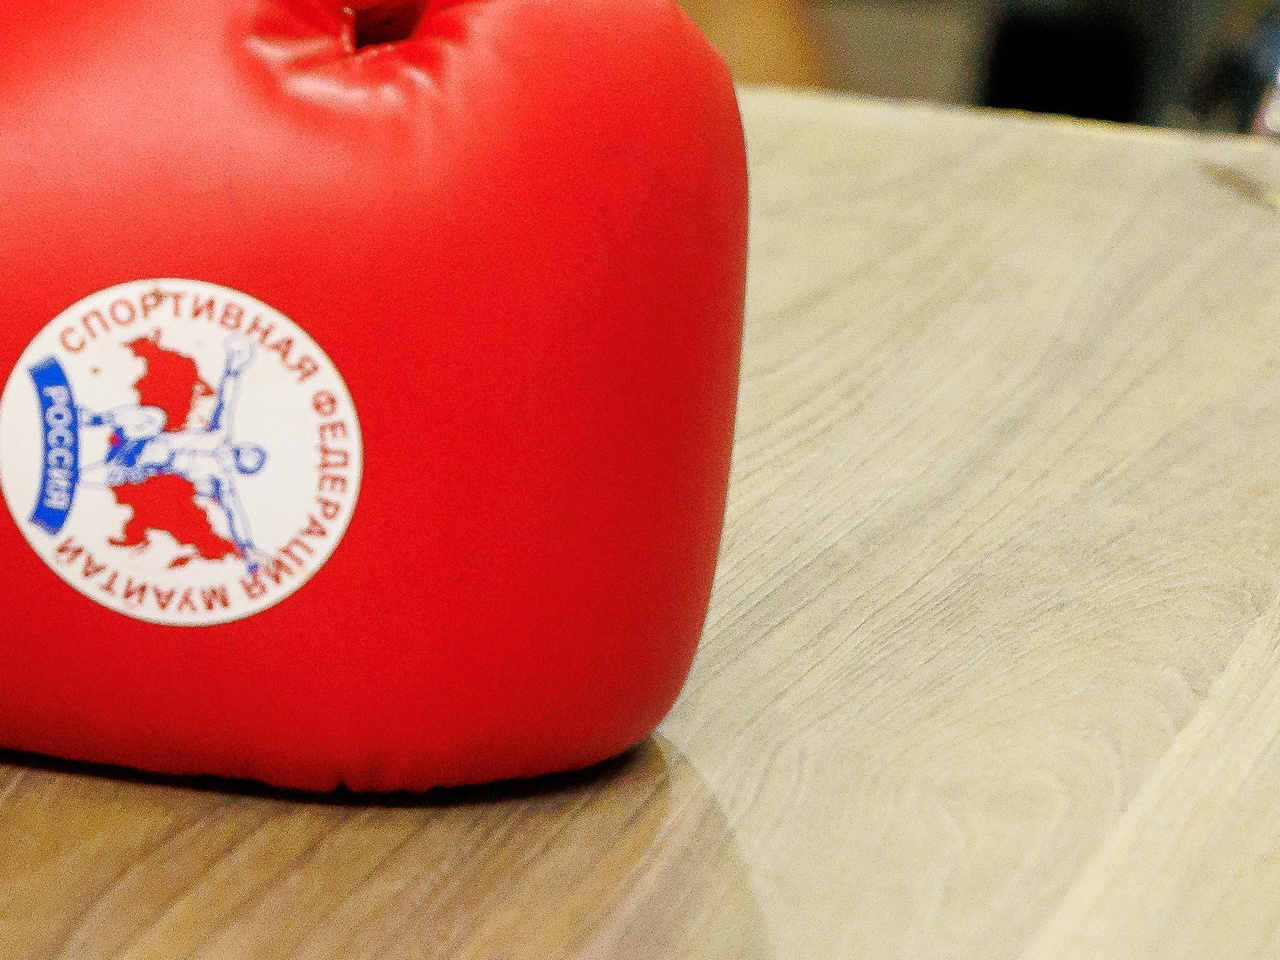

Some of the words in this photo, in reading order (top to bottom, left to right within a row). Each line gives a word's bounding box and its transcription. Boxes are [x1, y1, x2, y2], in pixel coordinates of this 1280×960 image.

[42, 385, 74, 510] РОССИЯ
[59, 291, 320, 383] СПОРТИВНАЯ
[239, 389, 350, 600] ФЕДЕРАЦИЯ
